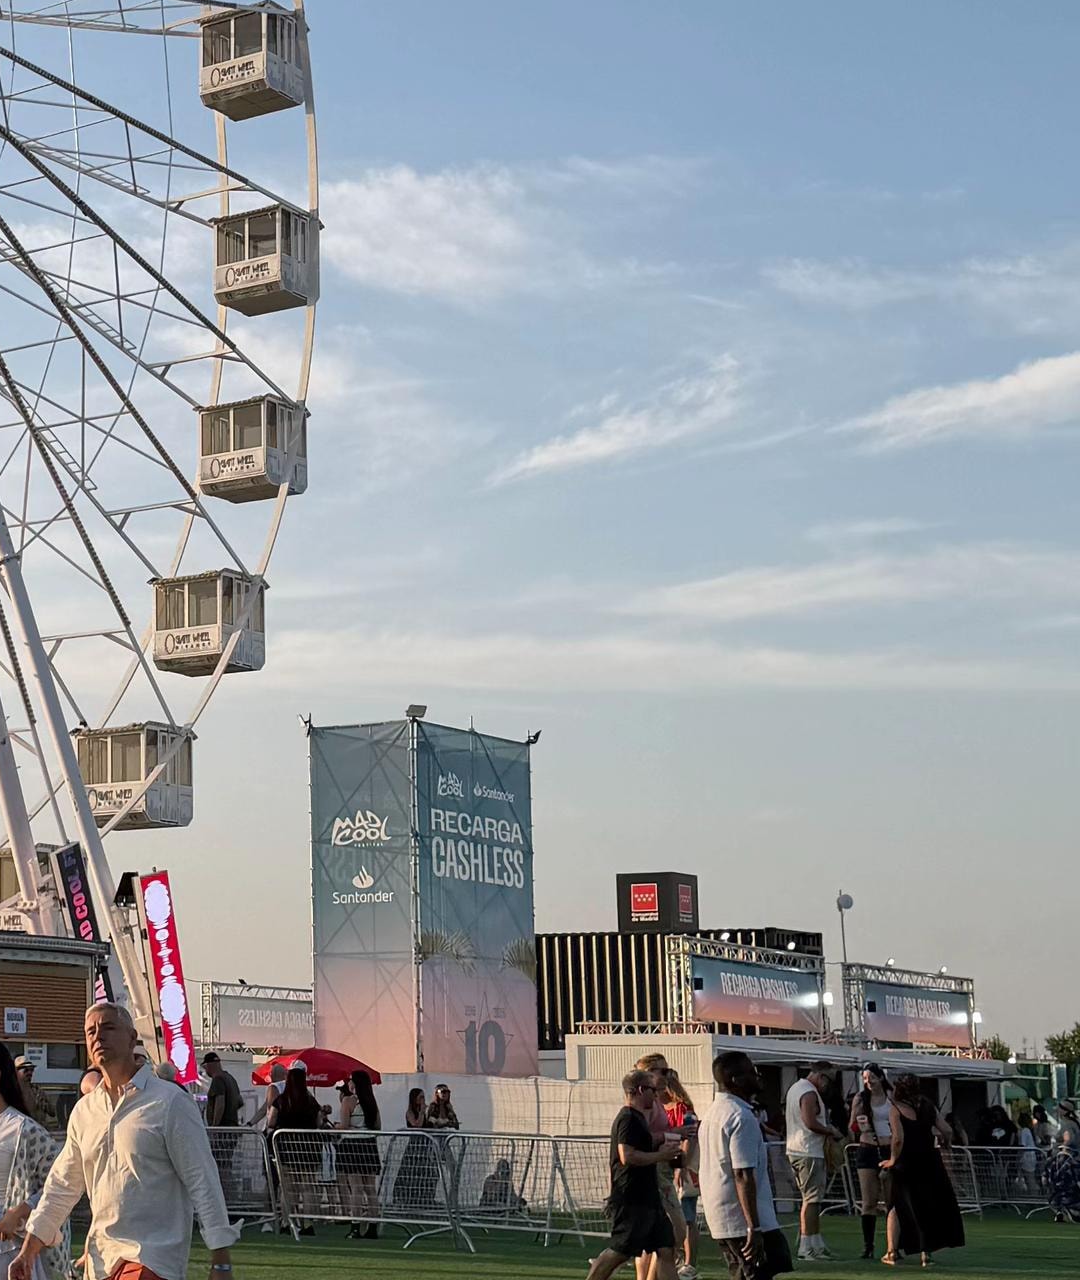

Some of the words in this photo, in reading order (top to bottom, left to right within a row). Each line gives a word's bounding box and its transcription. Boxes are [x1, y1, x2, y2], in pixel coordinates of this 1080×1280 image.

[331, 810, 382, 847] MAD
[334, 815, 392, 846] COOL
[431, 807, 524, 845] RECARGA
[431, 836, 525, 889] CASHLESS
[332, 891, 394, 905] Santander
